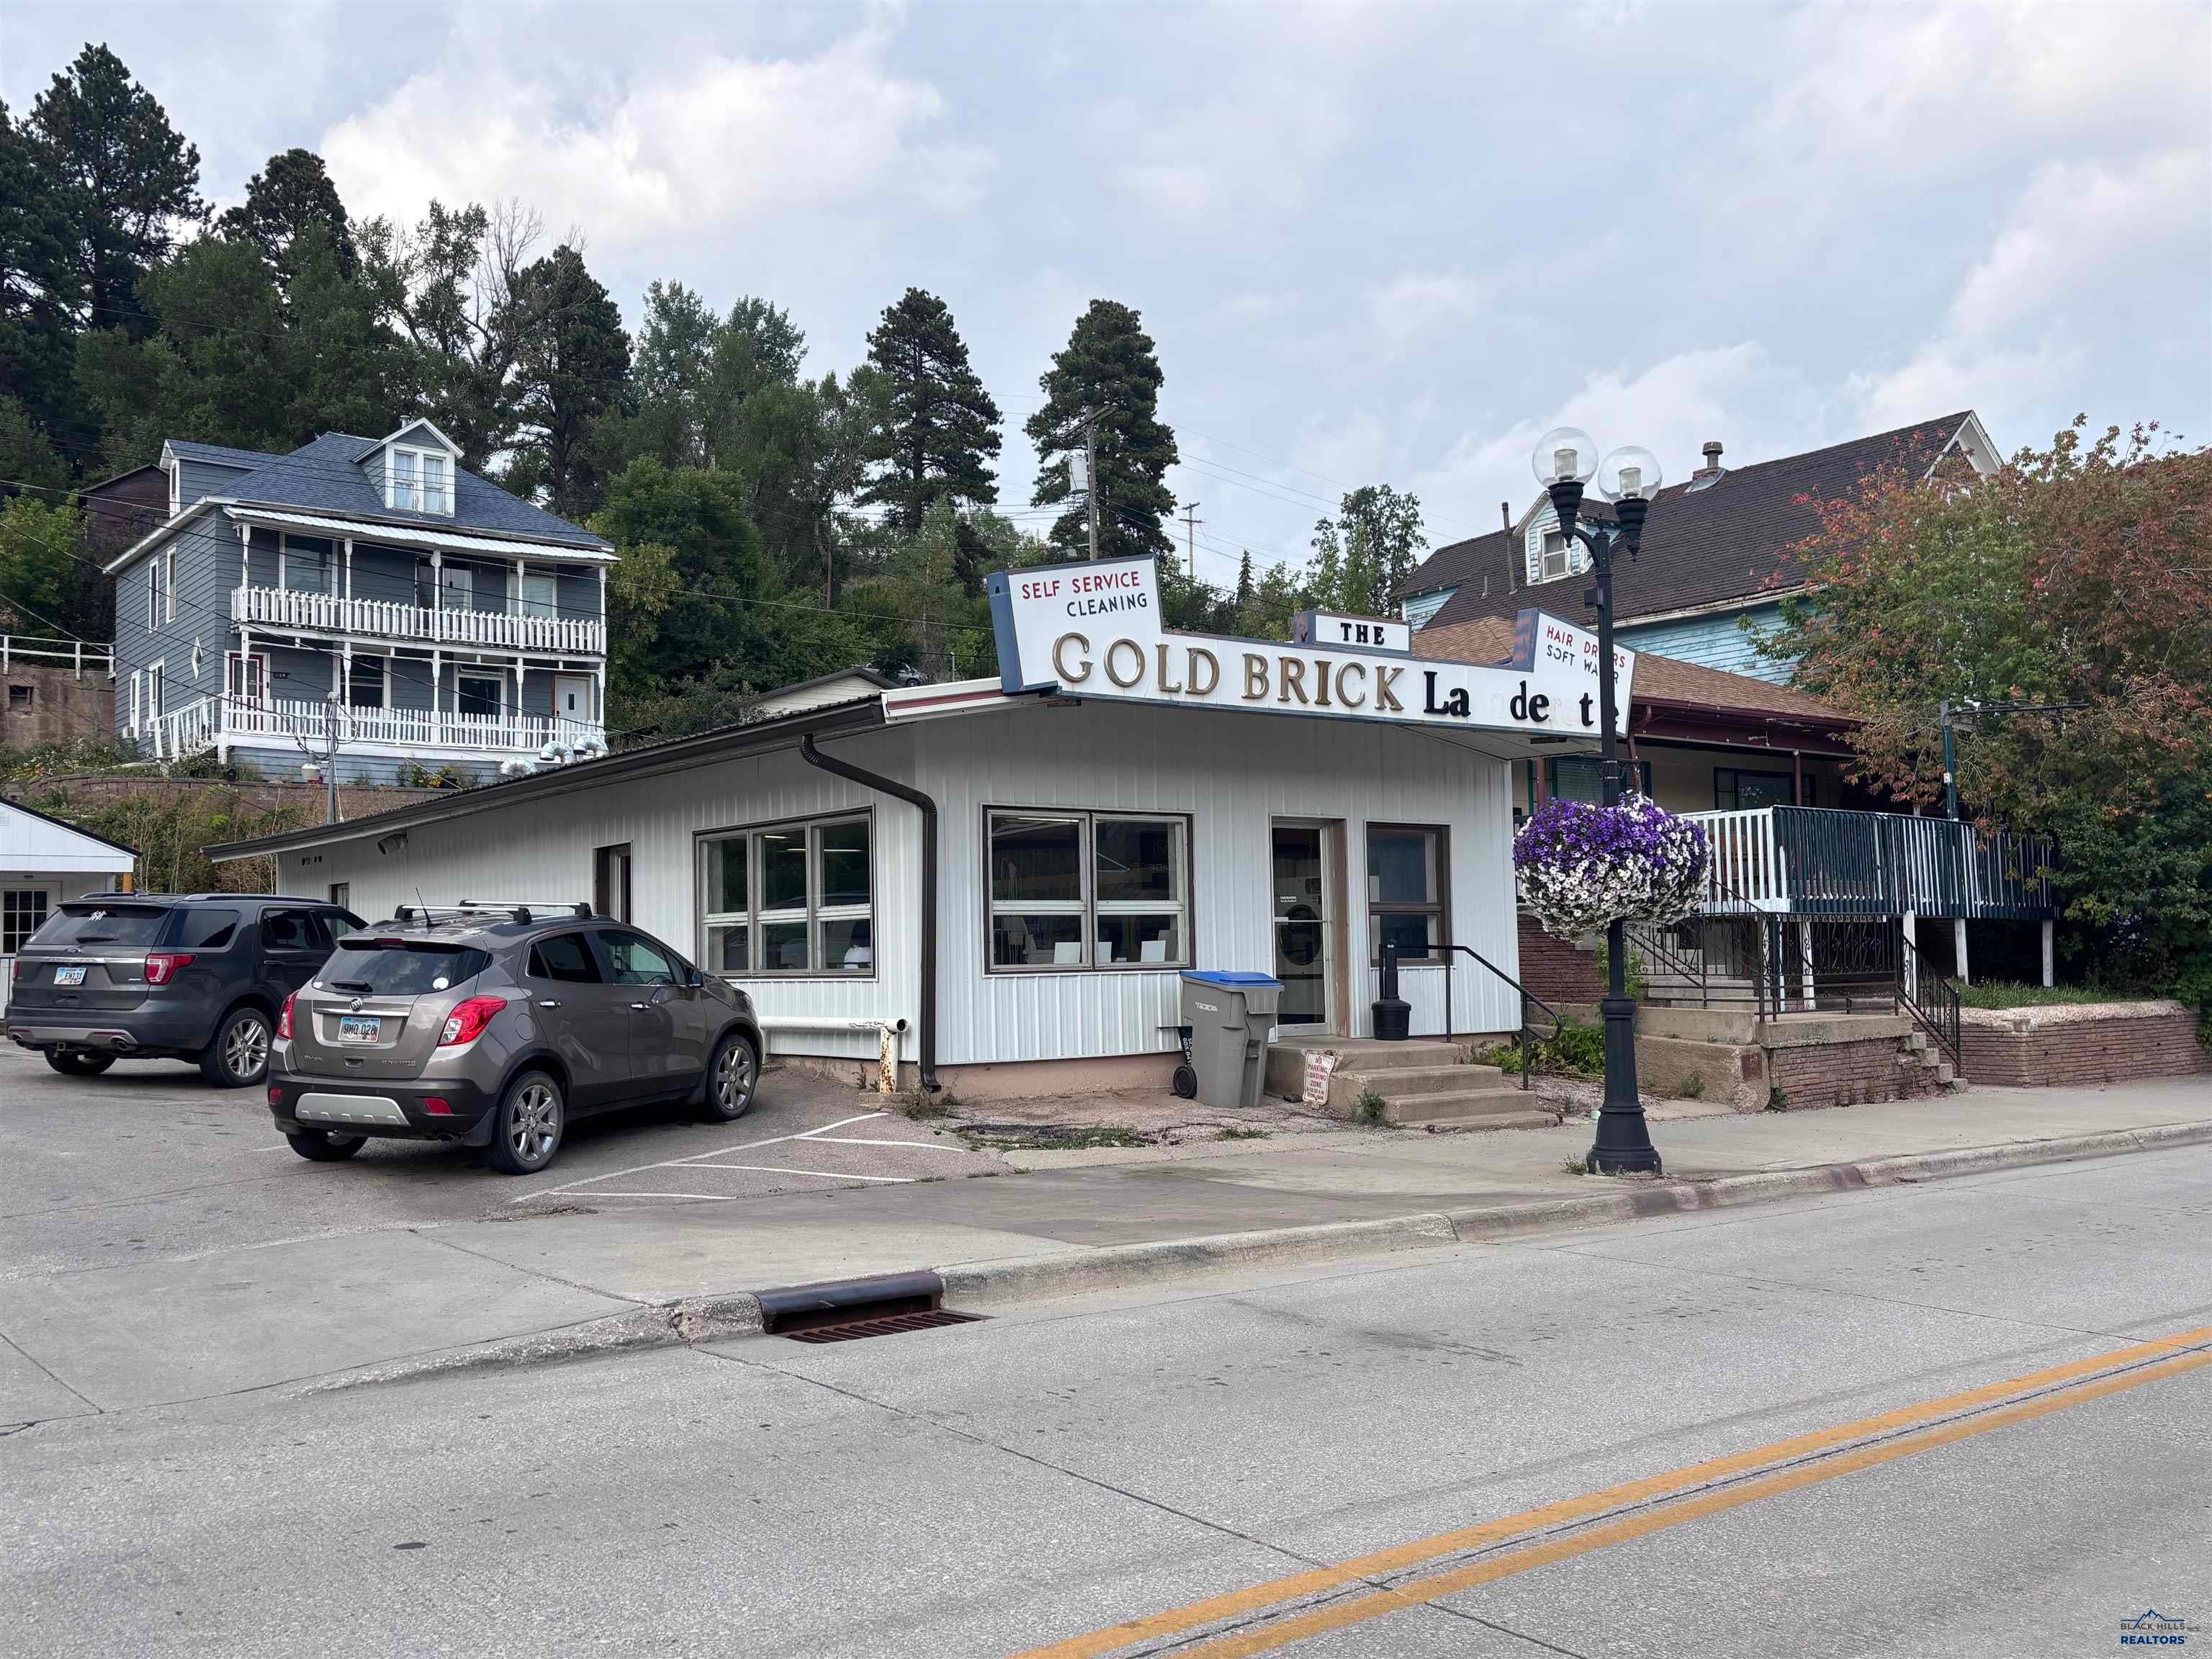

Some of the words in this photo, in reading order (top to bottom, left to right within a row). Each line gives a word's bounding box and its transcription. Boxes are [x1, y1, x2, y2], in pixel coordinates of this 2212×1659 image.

[1022, 580, 1061, 600] SELF
[1071, 571, 1141, 594] SERVICE
[1066, 593, 1148, 617] CLEANING
[1340, 622, 1385, 644] THE
[1547, 625, 1573, 647] HAIR
[1584, 641, 1625, 668] DRRS
[1052, 632, 1220, 695] GOLD
[1241, 653, 1405, 711] BRICK
[1547, 644, 1575, 666] SOFT
[1584, 659, 1619, 684] WAR
[1307, 1071, 1326, 1081] LOADING
[1308, 1064, 1328, 1073] PARKING
